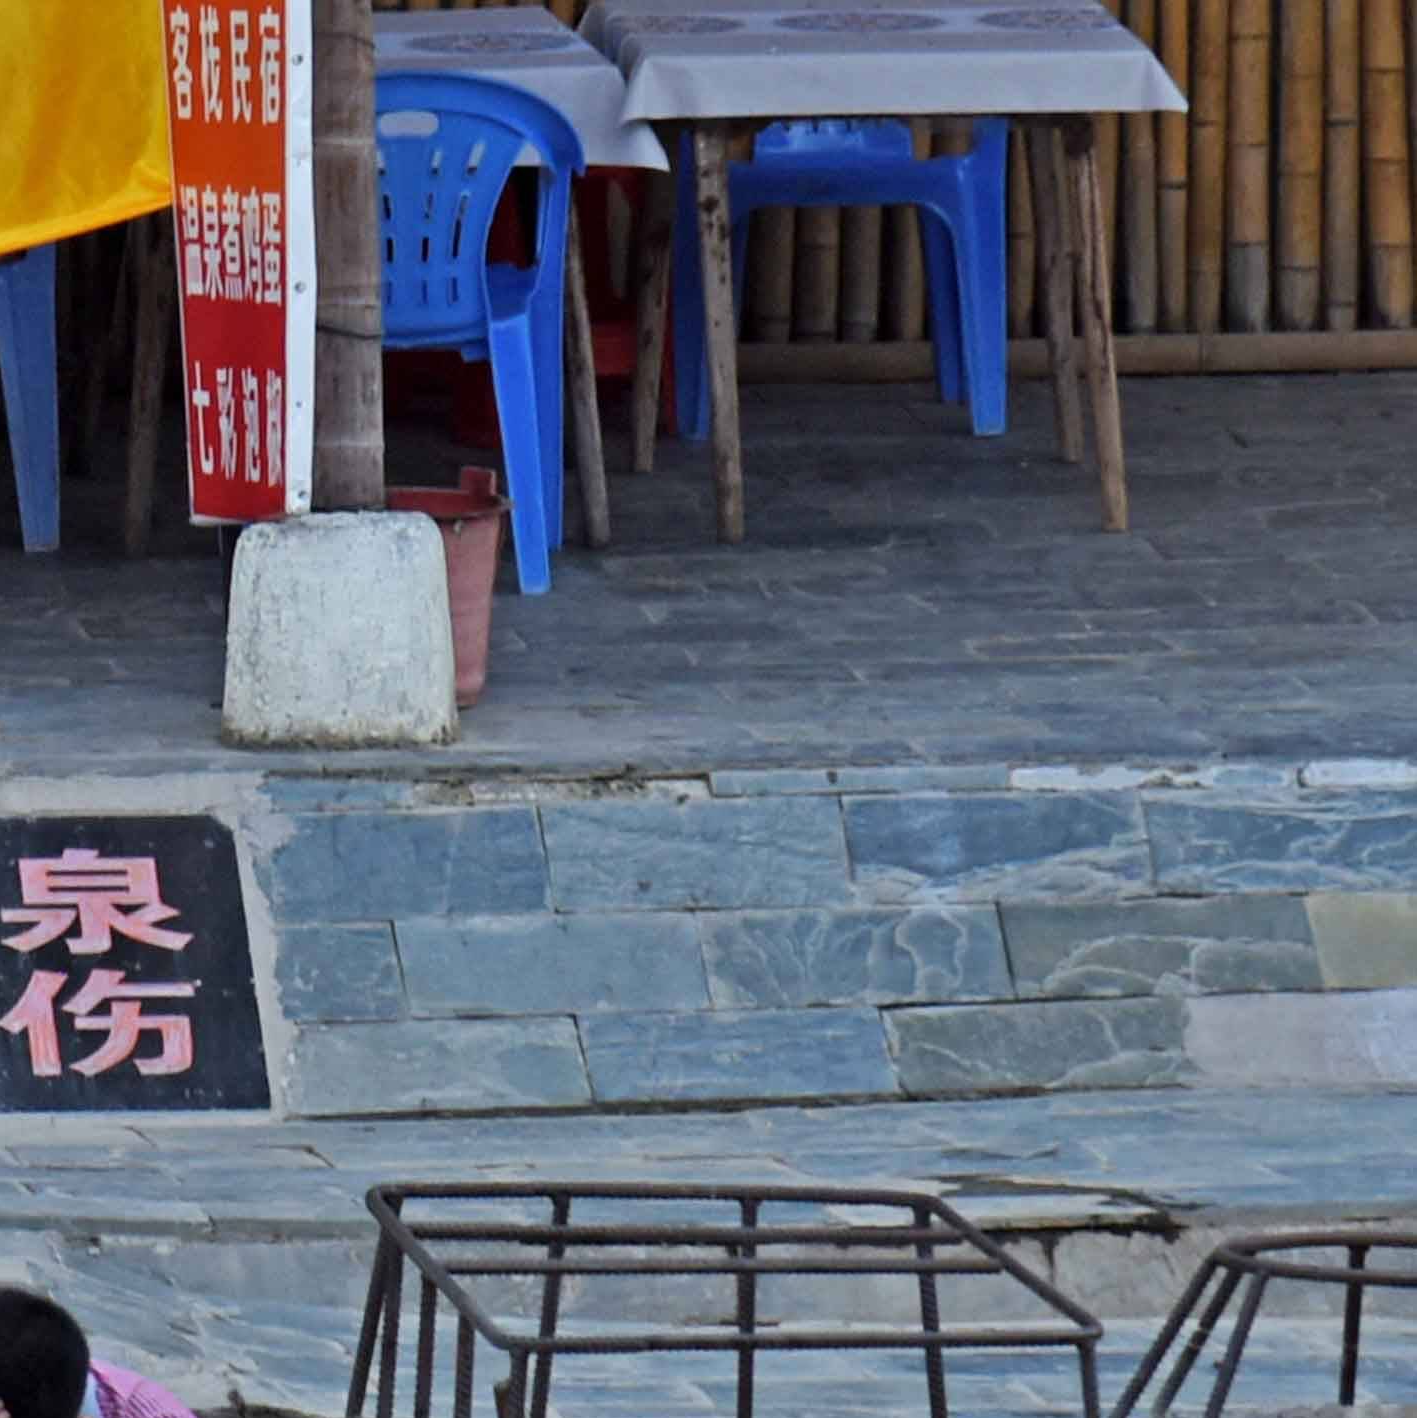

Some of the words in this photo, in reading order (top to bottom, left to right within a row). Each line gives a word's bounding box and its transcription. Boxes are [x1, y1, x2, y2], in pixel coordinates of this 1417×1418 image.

[170, 4, 280, 125] 客栈民宿
[181, 184, 282, 306] 温泉煮鸡蛋
